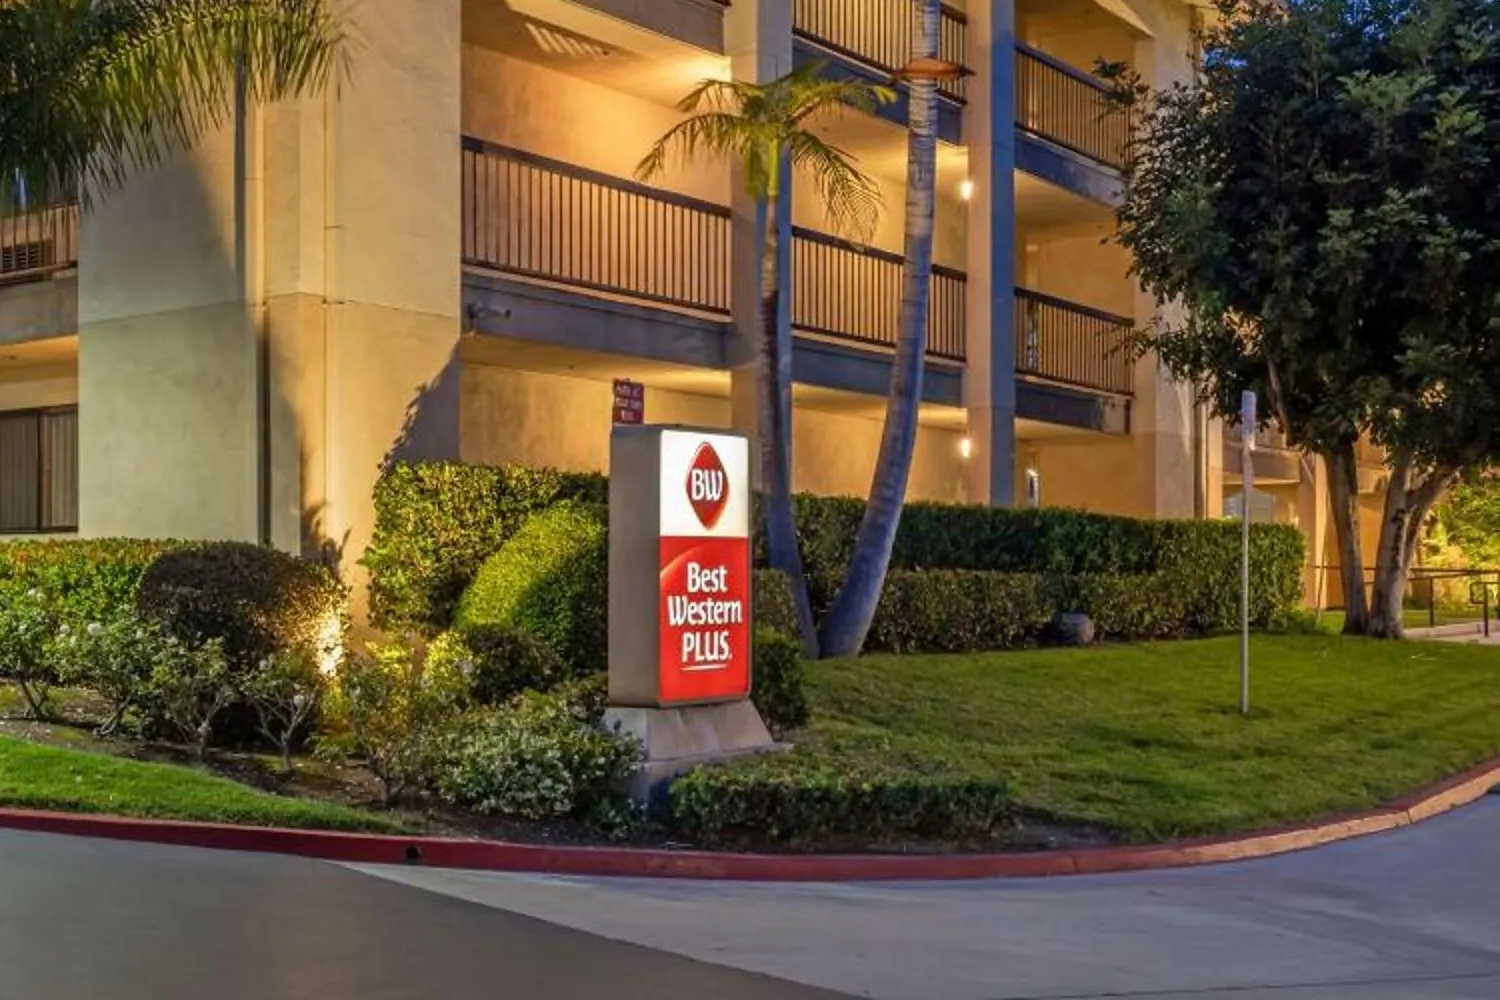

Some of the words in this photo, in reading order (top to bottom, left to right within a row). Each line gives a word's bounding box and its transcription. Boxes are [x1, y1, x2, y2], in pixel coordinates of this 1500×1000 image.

[691, 468, 723, 501] BW
[687, 562, 728, 593] Best
[667, 595, 742, 626] Western
